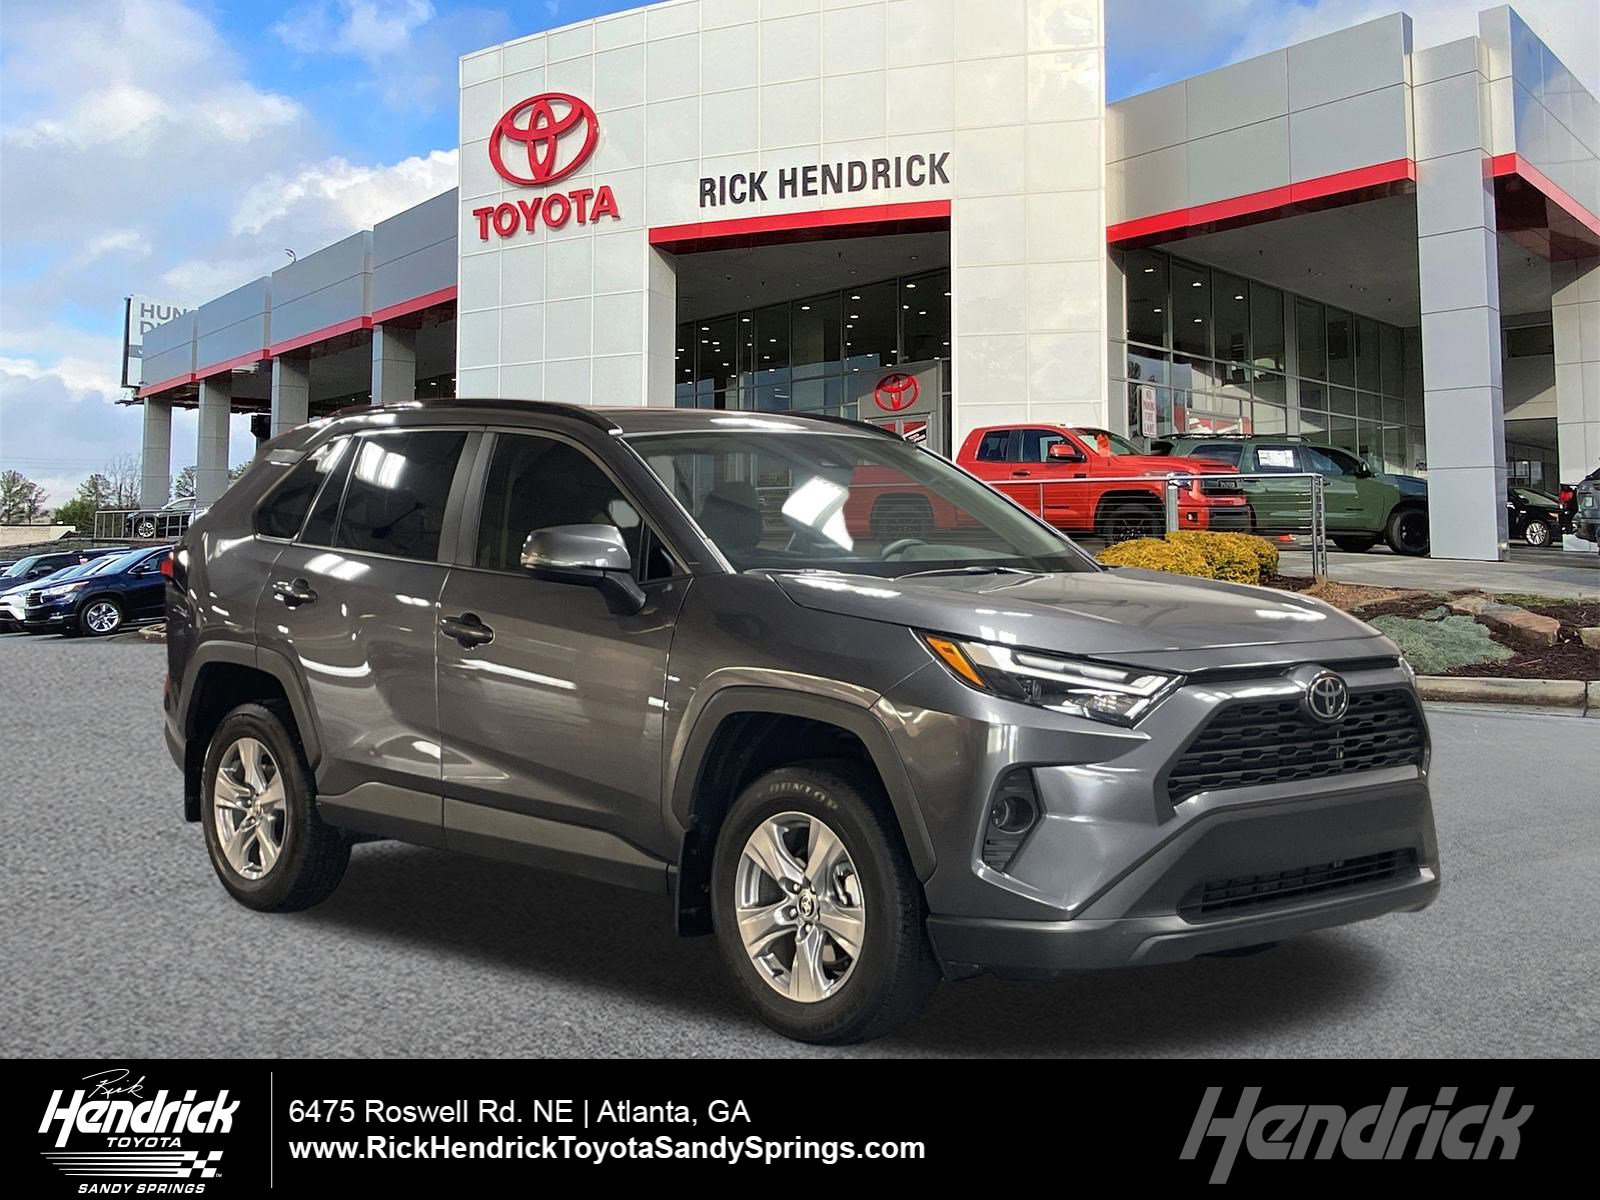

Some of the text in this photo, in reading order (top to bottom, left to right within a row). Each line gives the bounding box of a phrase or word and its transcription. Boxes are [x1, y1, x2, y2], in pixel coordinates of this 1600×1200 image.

[700, 152, 951, 208] RICK HENDRICK
[473, 185, 621, 241] TOYOTA
[769, 782, 839, 810] DUNLOP
